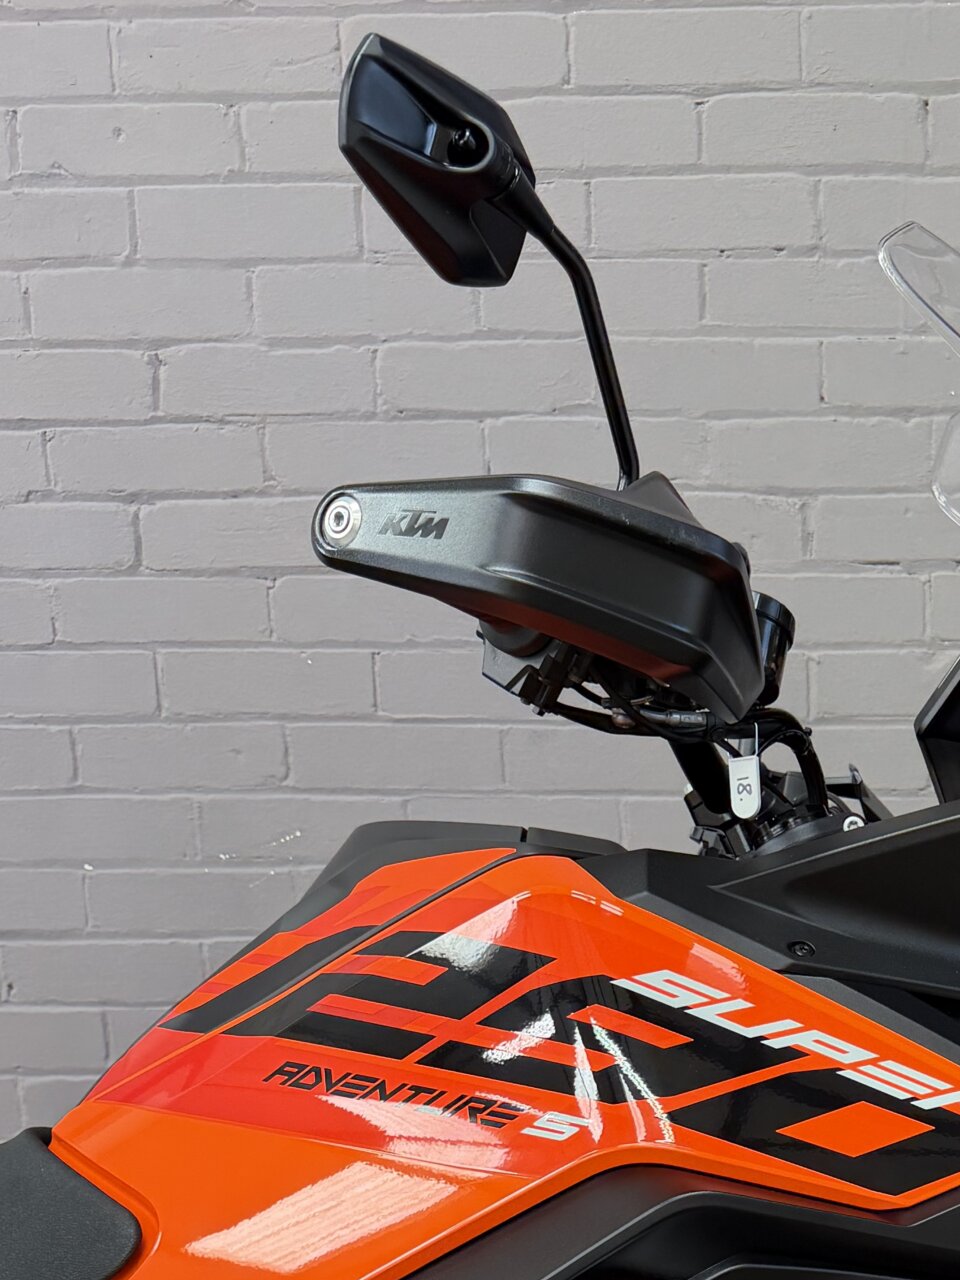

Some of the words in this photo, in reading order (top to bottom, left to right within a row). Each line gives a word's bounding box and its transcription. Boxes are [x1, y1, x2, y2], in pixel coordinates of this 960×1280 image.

[379, 508, 450, 540] KTM
[263, 1060, 529, 1130] ADVENTURE
[520, 1112, 590, 1142] S
